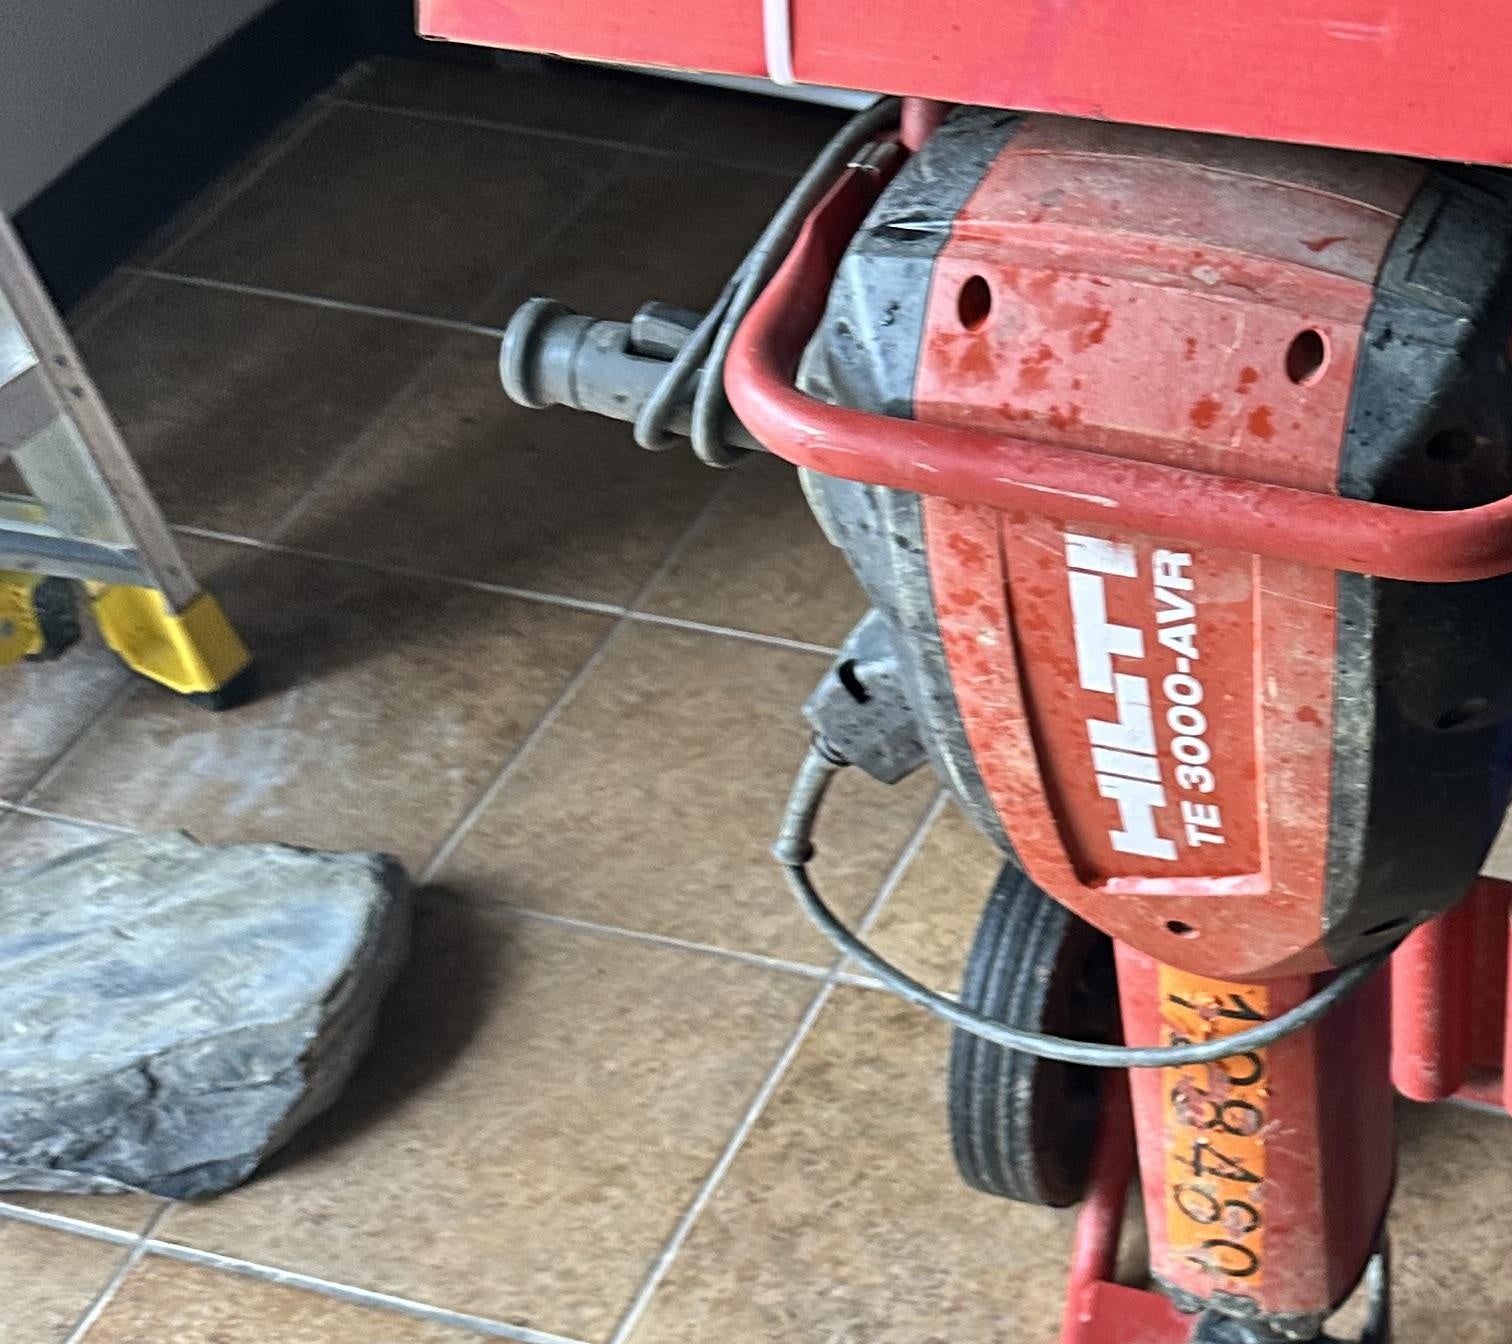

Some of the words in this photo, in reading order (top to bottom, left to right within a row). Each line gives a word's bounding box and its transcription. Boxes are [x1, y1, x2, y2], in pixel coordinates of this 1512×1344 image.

[1063, 531, 1178, 861] HILTI
[1152, 548, 1216, 794] 3000-AVR
[1180, 800, 1226, 849] TE
